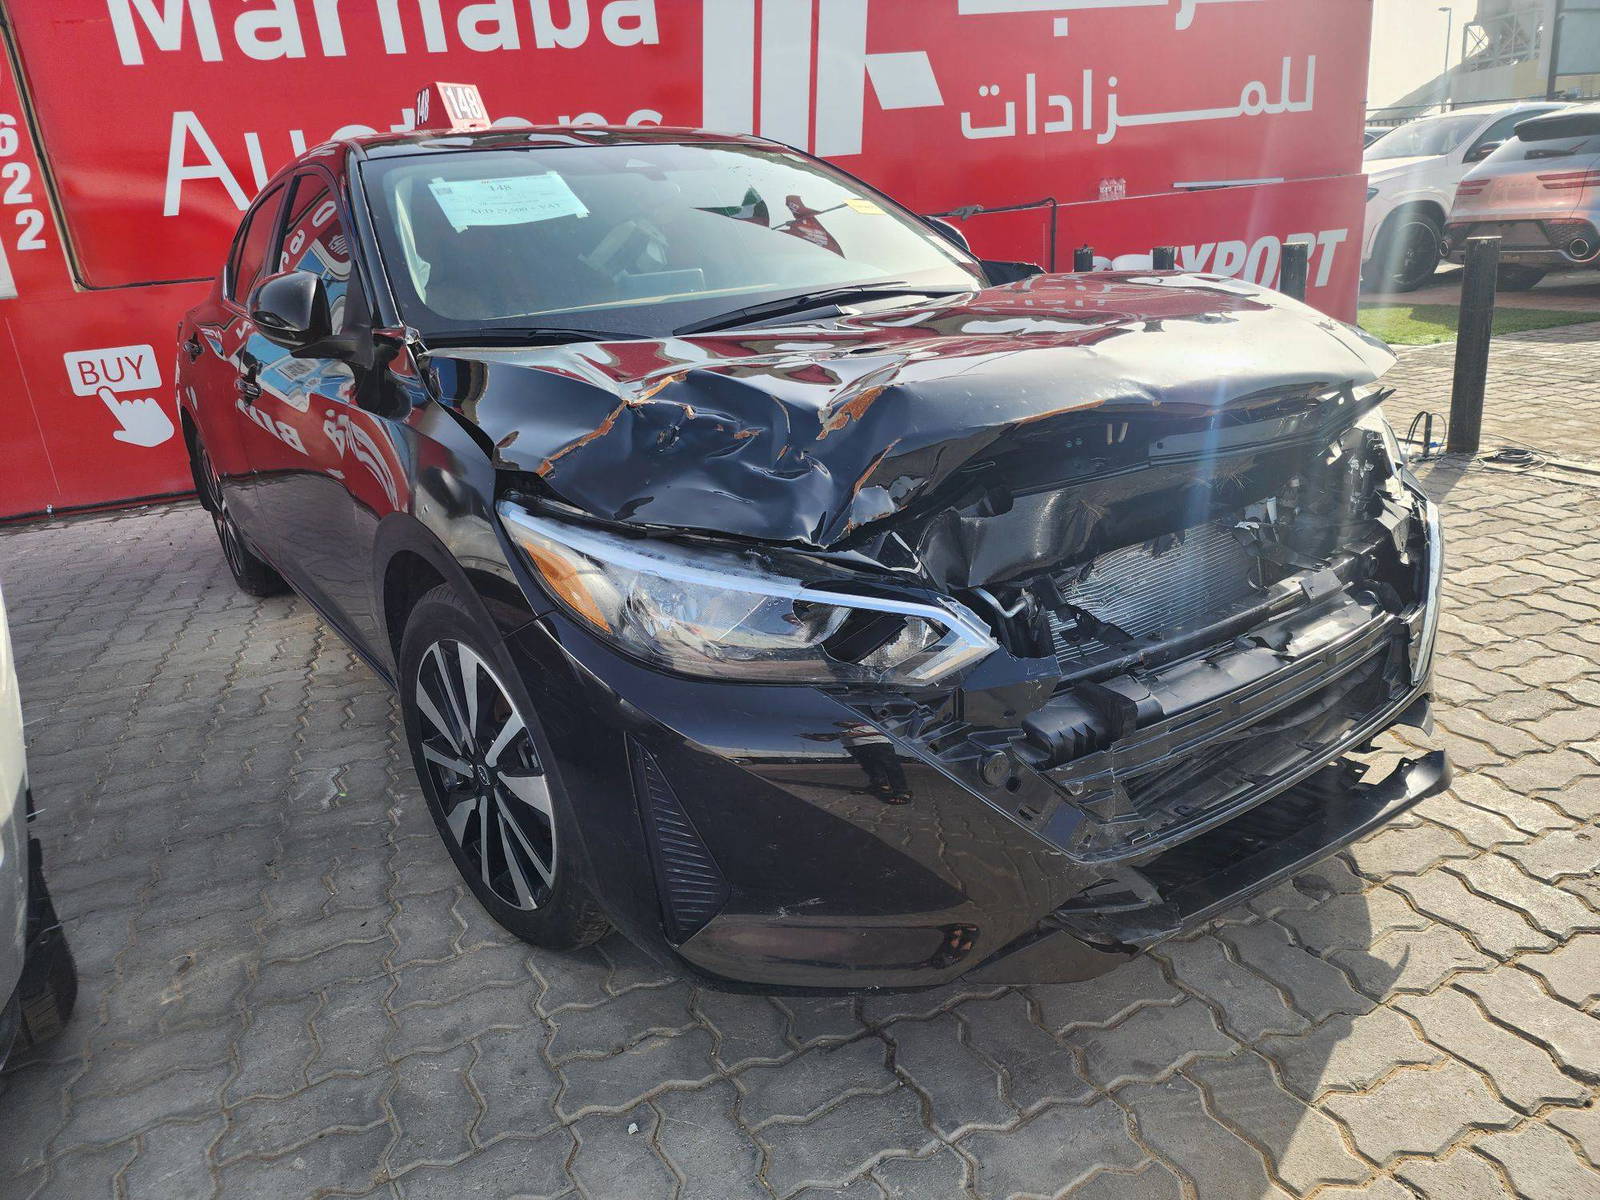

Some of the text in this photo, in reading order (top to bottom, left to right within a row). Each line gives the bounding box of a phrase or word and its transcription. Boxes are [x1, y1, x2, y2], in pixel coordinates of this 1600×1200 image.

[416, 87, 431, 126] 148
[445, 86, 483, 120] 148
[77, 354, 144, 386] BUY
